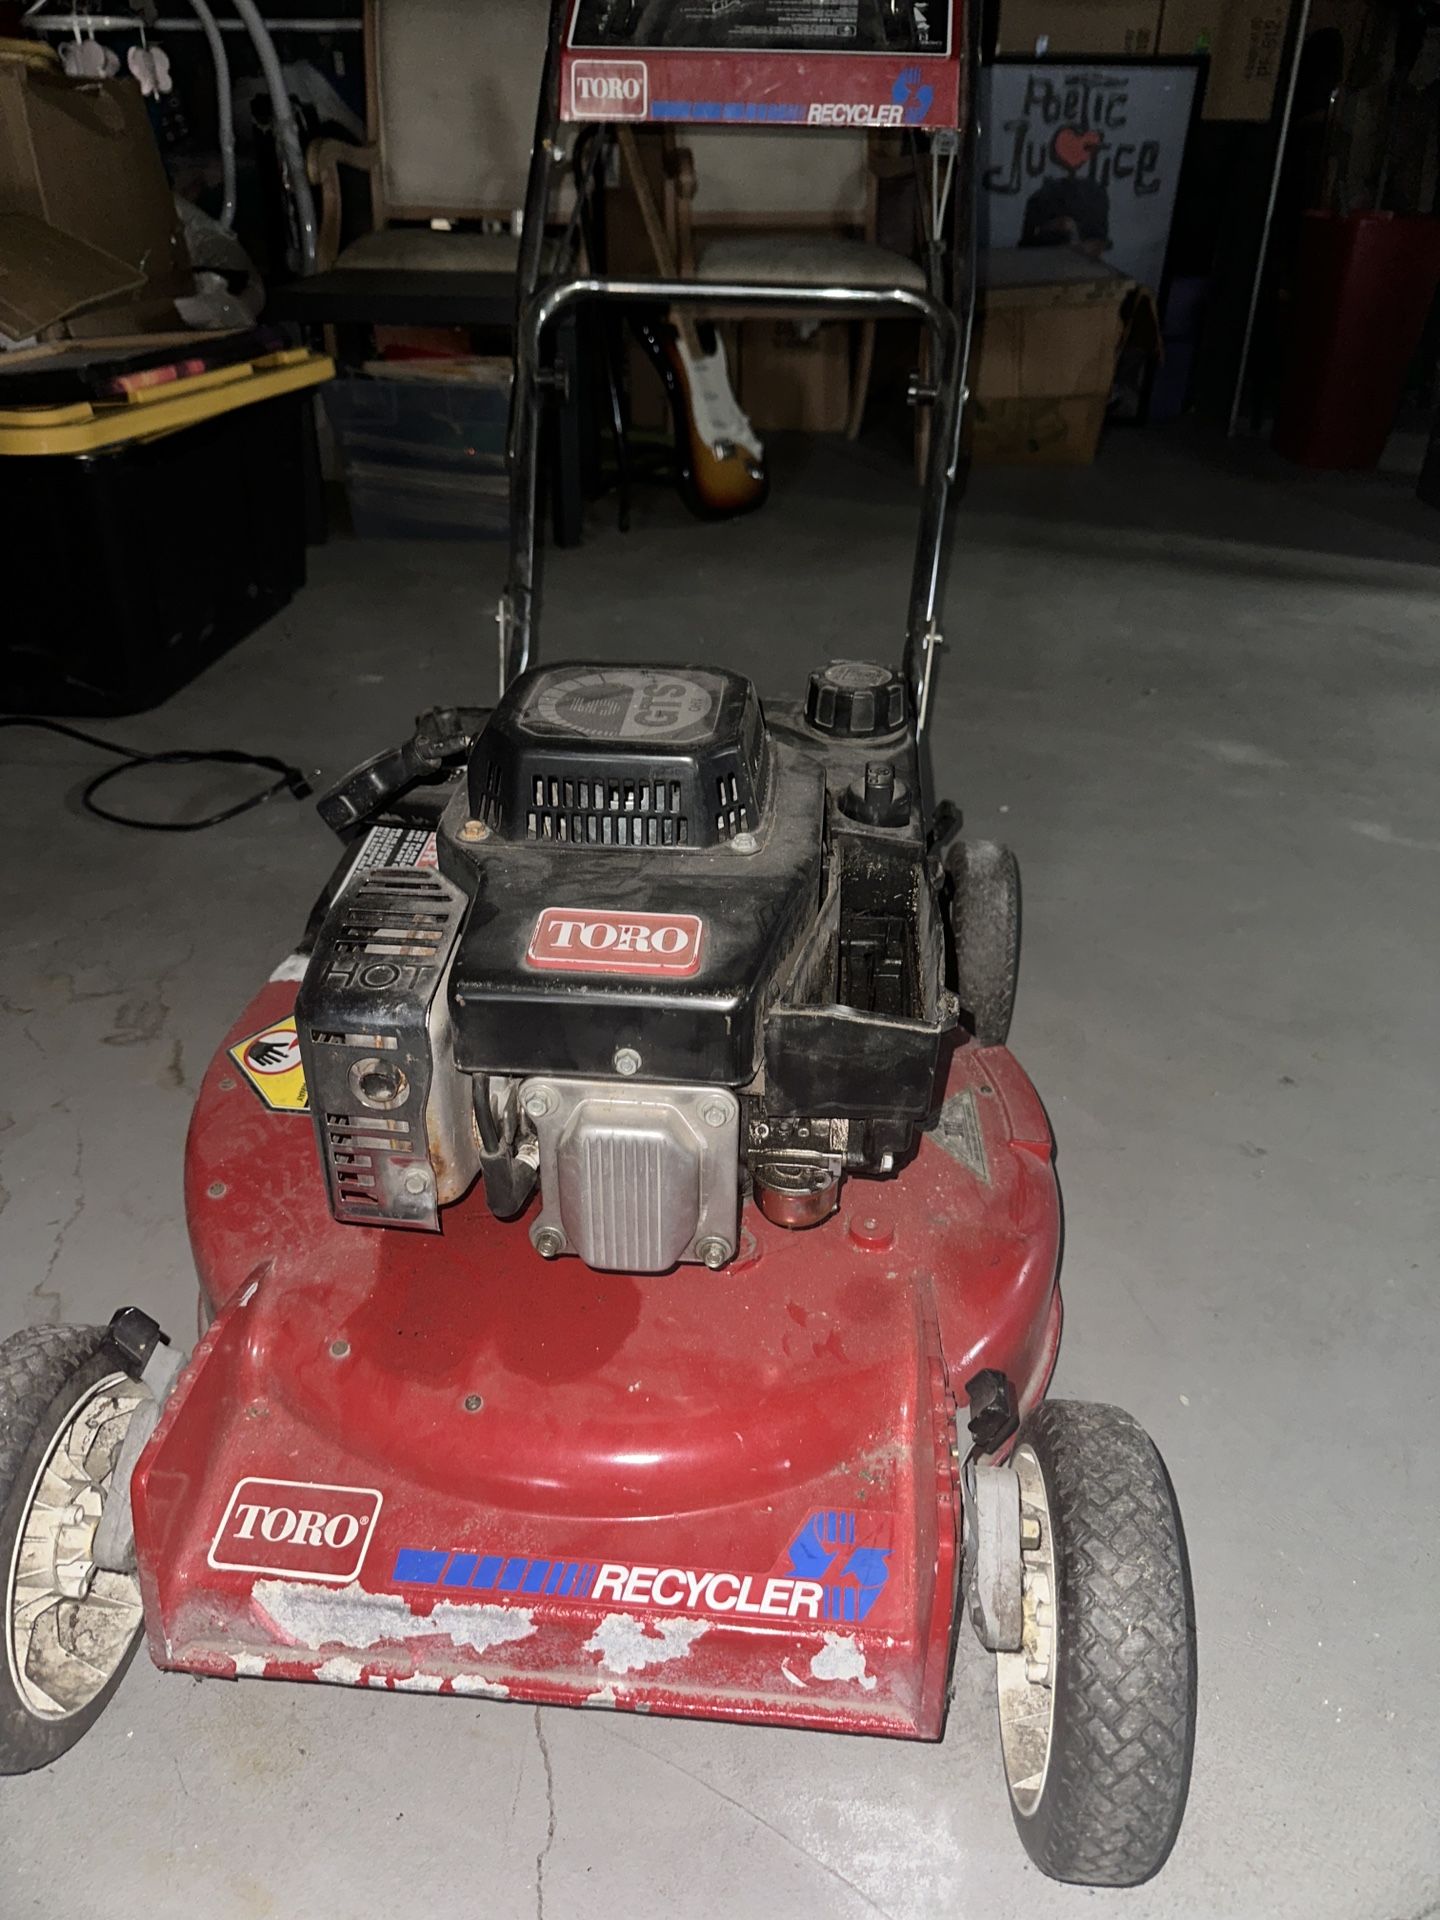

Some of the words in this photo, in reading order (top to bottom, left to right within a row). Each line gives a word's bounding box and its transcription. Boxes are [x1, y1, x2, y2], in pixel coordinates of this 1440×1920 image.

[577, 77, 640, 99] TORO
[807, 104, 904, 123] RECYCLER
[634, 684, 686, 727] GTS
[548, 920, 689, 954] TORO
[321, 961, 435, 990] HOT
[592, 1563, 823, 1619] RECYCLER
